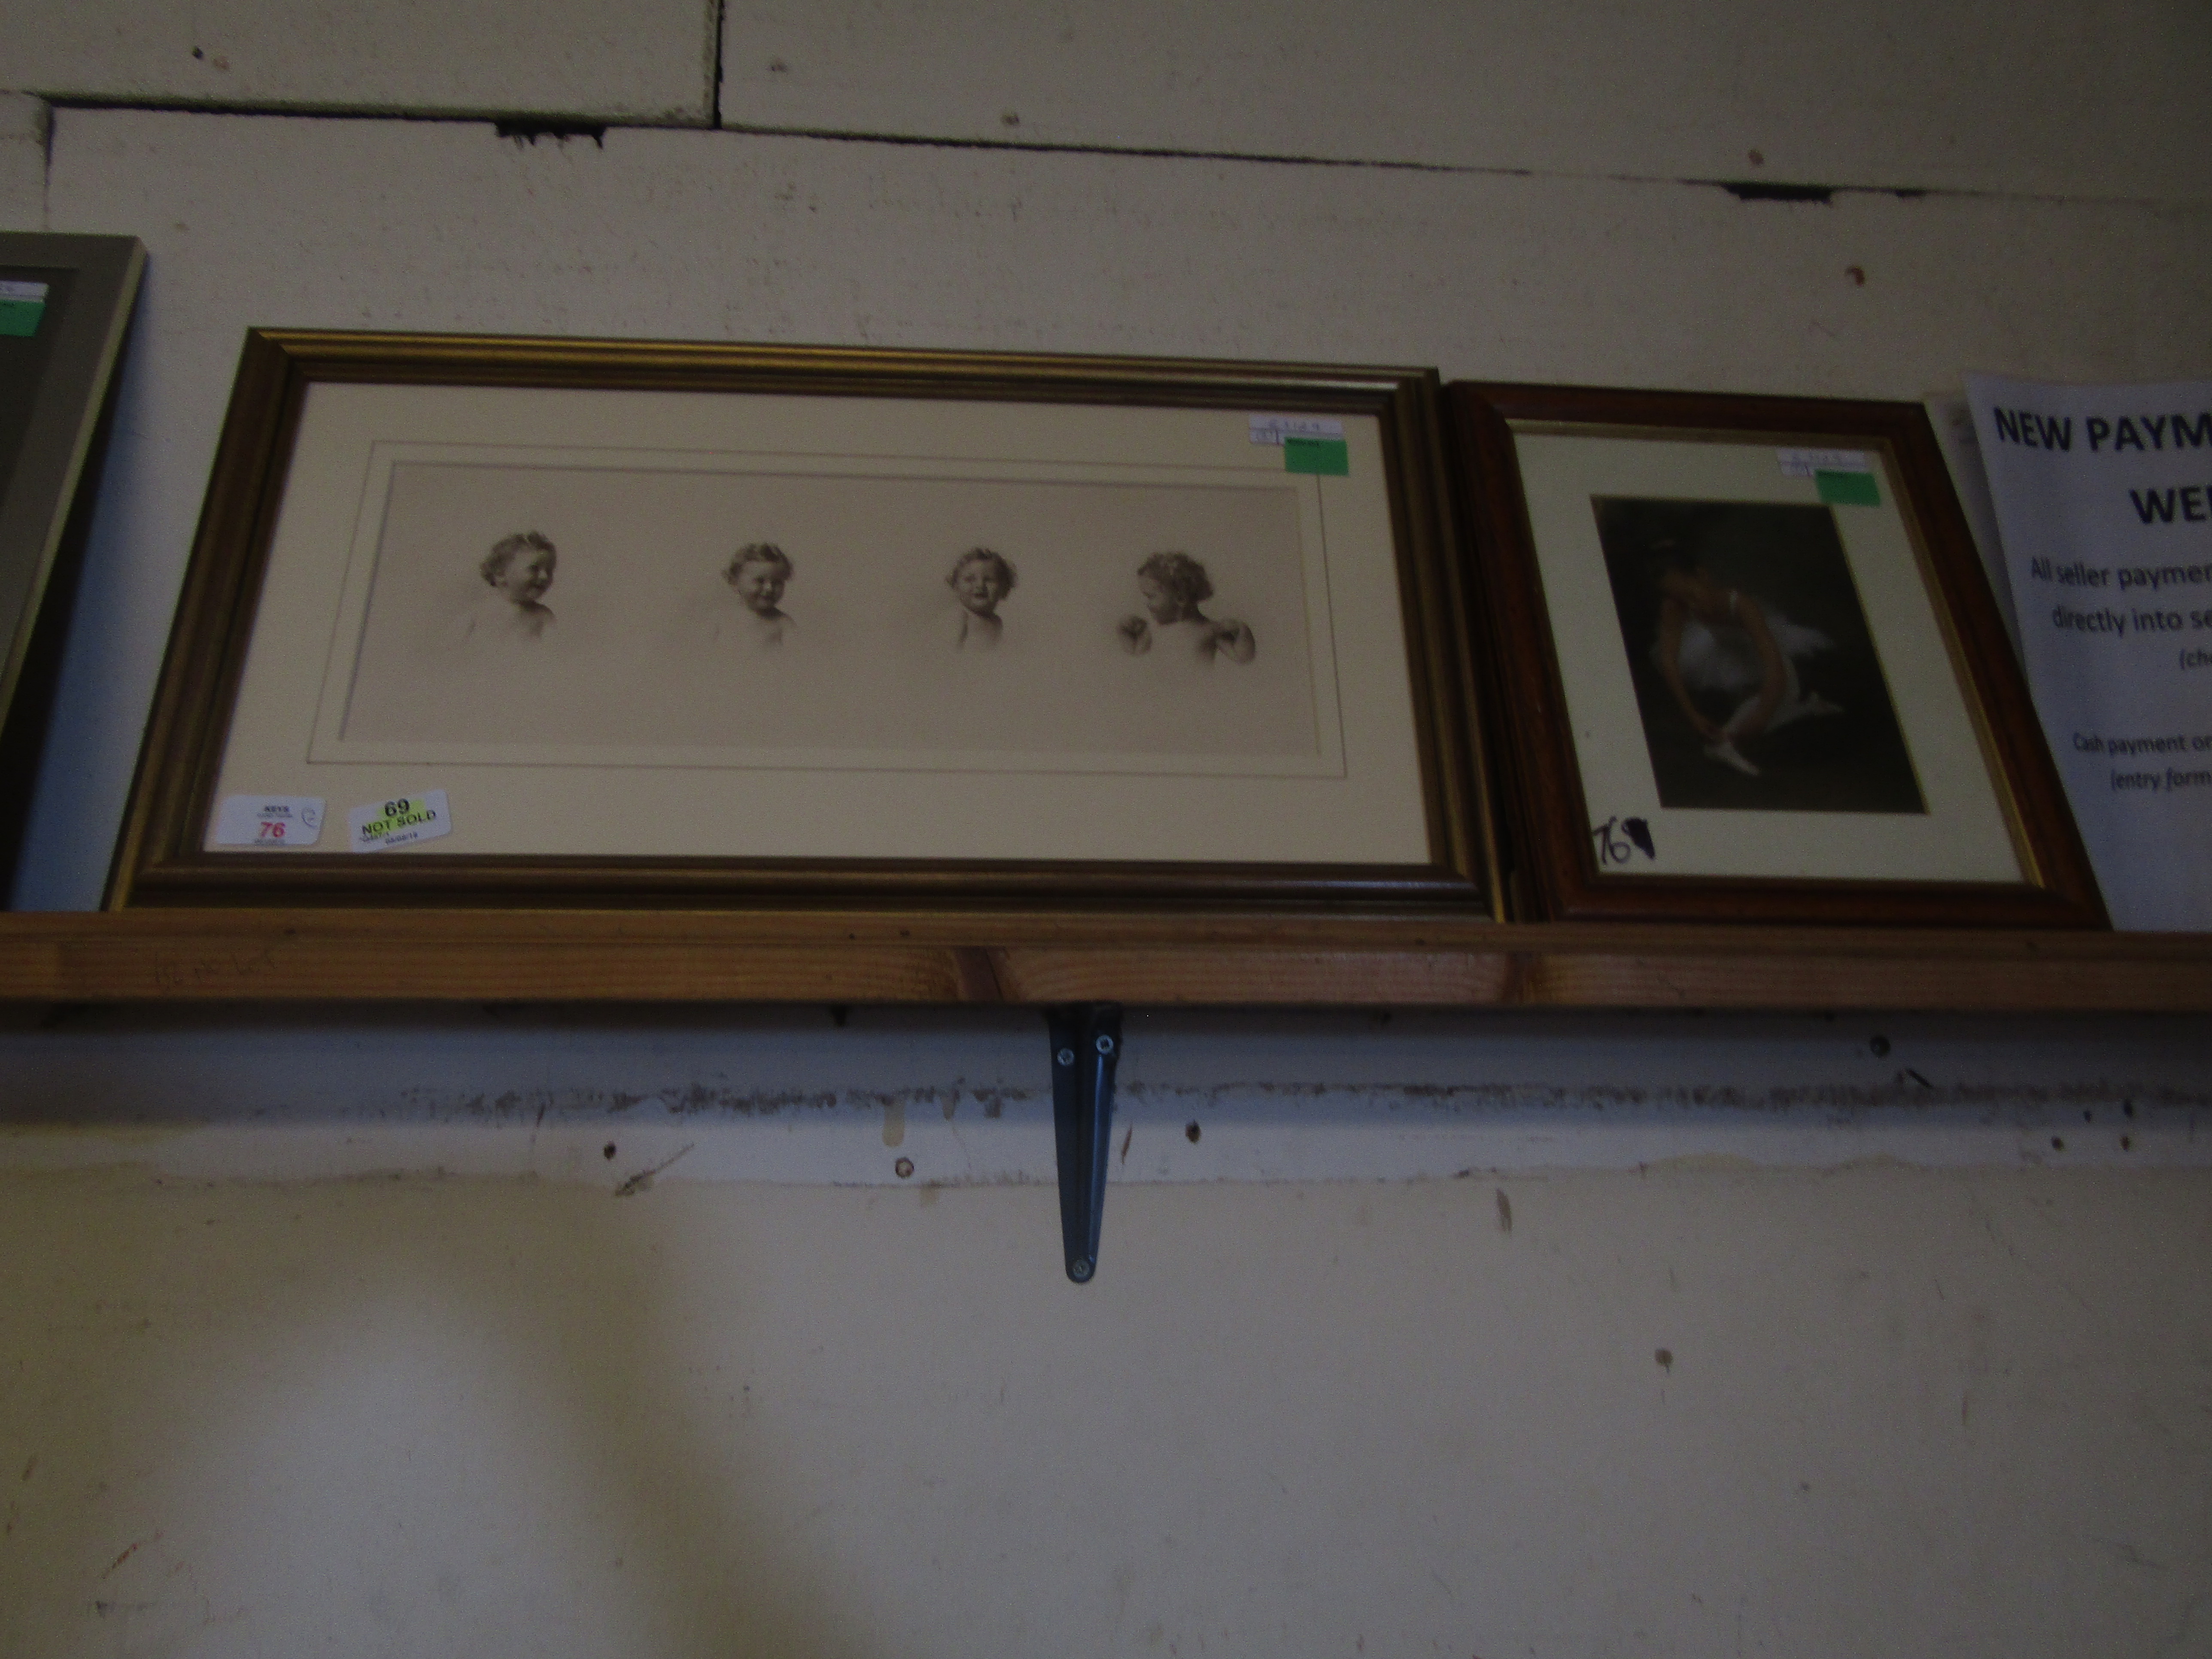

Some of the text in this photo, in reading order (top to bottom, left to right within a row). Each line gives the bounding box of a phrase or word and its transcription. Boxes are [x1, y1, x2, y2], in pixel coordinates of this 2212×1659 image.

[1994, 406, 2212, 451] NEW PAYM
[2129, 484, 2212, 524] WE
[2032, 556, 2053, 582] All
[2057, 563, 2109, 587] seller
[2052, 605, 2126, 638] directly
[2132, 608, 2183, 631] into
[2073, 732, 2103, 752] Cash
[2108, 735, 2185, 758] payment
[2111, 769, 2160, 792] (entry
[385, 798, 410, 817] 69
[261, 822, 286, 837] 76
[362, 809, 436, 834] NOT SOLD
